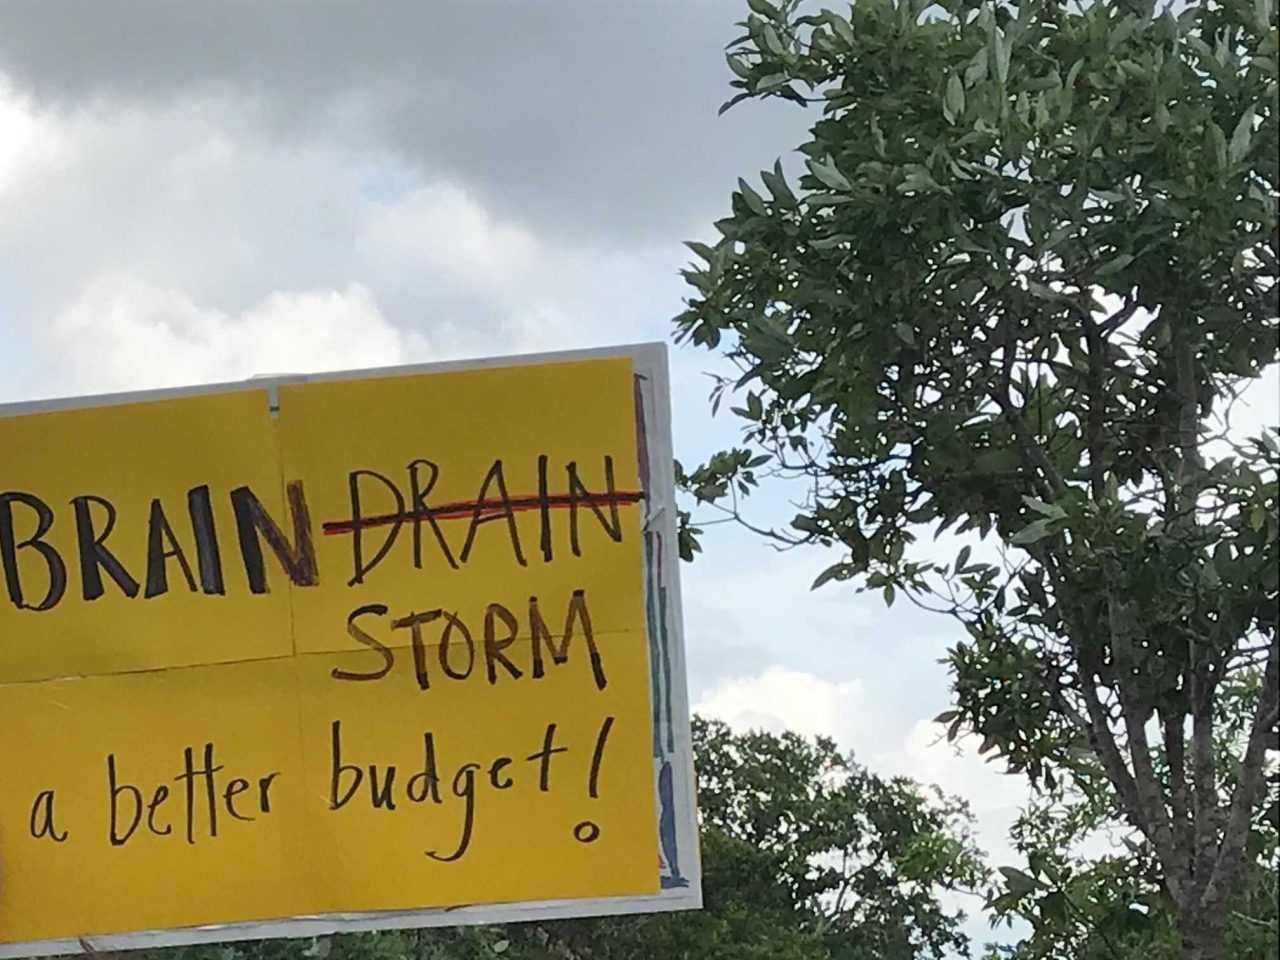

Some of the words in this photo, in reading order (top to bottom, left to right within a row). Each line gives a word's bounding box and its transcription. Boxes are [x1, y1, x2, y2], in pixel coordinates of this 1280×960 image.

[347, 454, 623, 585] DRAIN
[331, 589, 607, 690] STORM
[30, 792, 68, 843] a
[108, 743, 280, 846] better
[328, 716, 615, 862] budget!
